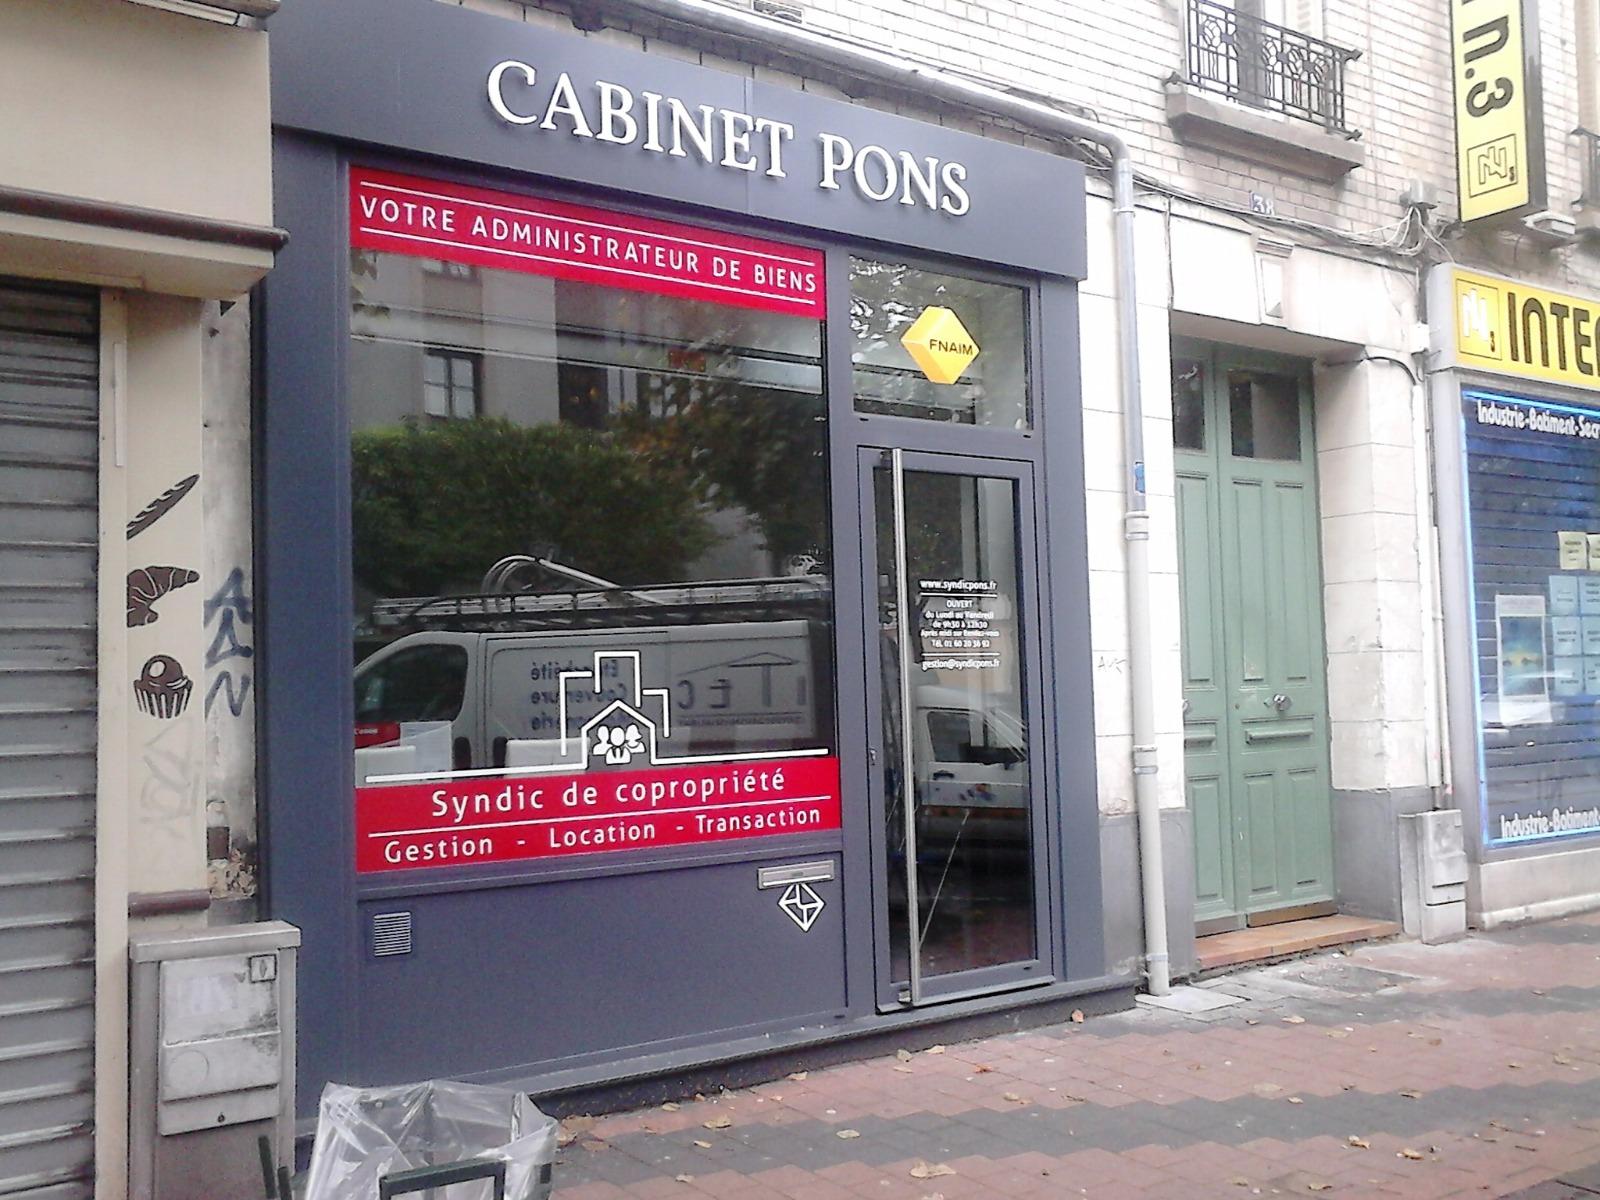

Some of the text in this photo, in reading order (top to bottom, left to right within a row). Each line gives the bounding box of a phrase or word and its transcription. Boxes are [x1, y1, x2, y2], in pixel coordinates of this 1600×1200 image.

[487, 60, 970, 216] CABINET PONS
[360, 195, 816, 293] VOTRE ADMINISTRATEUR DE BIENS
[929, 339, 974, 355] FNAIM
[1507, 291, 1600, 378] INTE
[920, 580, 997, 591] www.syndicpons.fr
[946, 600, 973, 608] OUVERT
[935, 611, 954, 619] Lundi
[964, 611, 994, 620] Vendredi
[432, 768, 785, 823] Syndic de copropriété
[384, 836, 493, 863] Gestion
[550, 821, 655, 848] Location
[695, 806, 820, 834] Transaction
